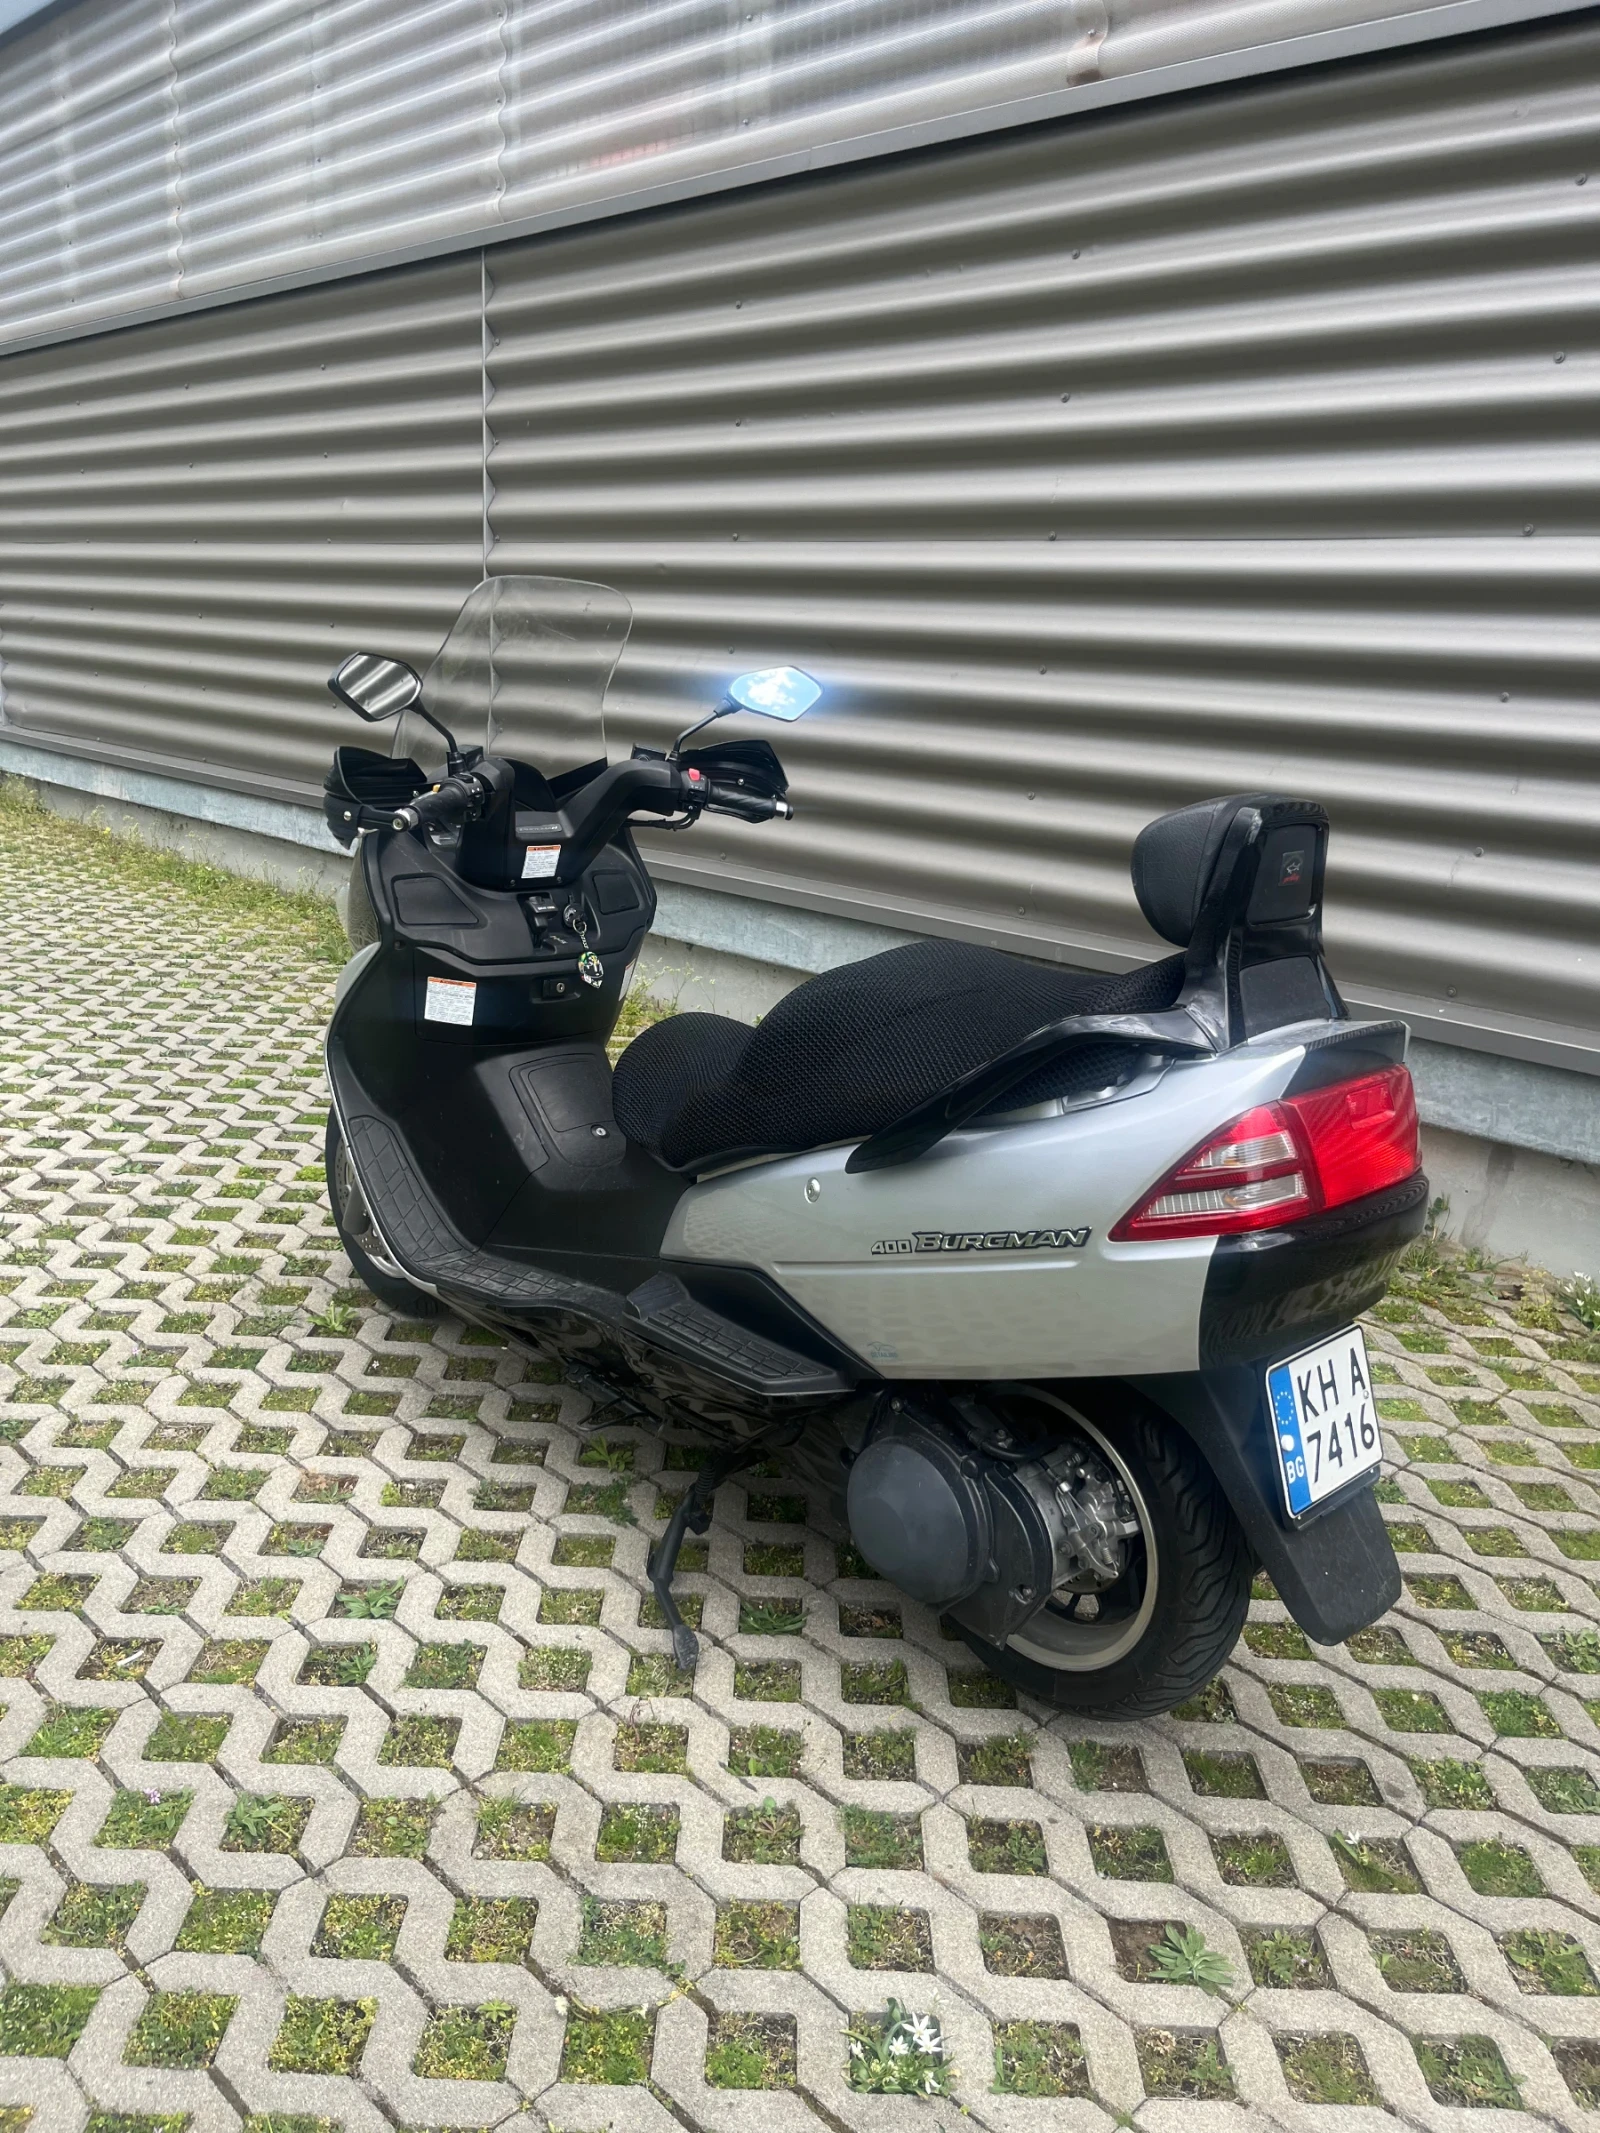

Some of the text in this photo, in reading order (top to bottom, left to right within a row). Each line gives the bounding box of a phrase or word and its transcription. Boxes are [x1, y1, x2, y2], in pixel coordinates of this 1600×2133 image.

[871, 1227, 1092, 1255] 400 BURGMAN
[1297, 1347, 1366, 1423] KH A
[1306, 1402, 1375, 1484] 7416
[1286, 1456, 1305, 1484] BG
